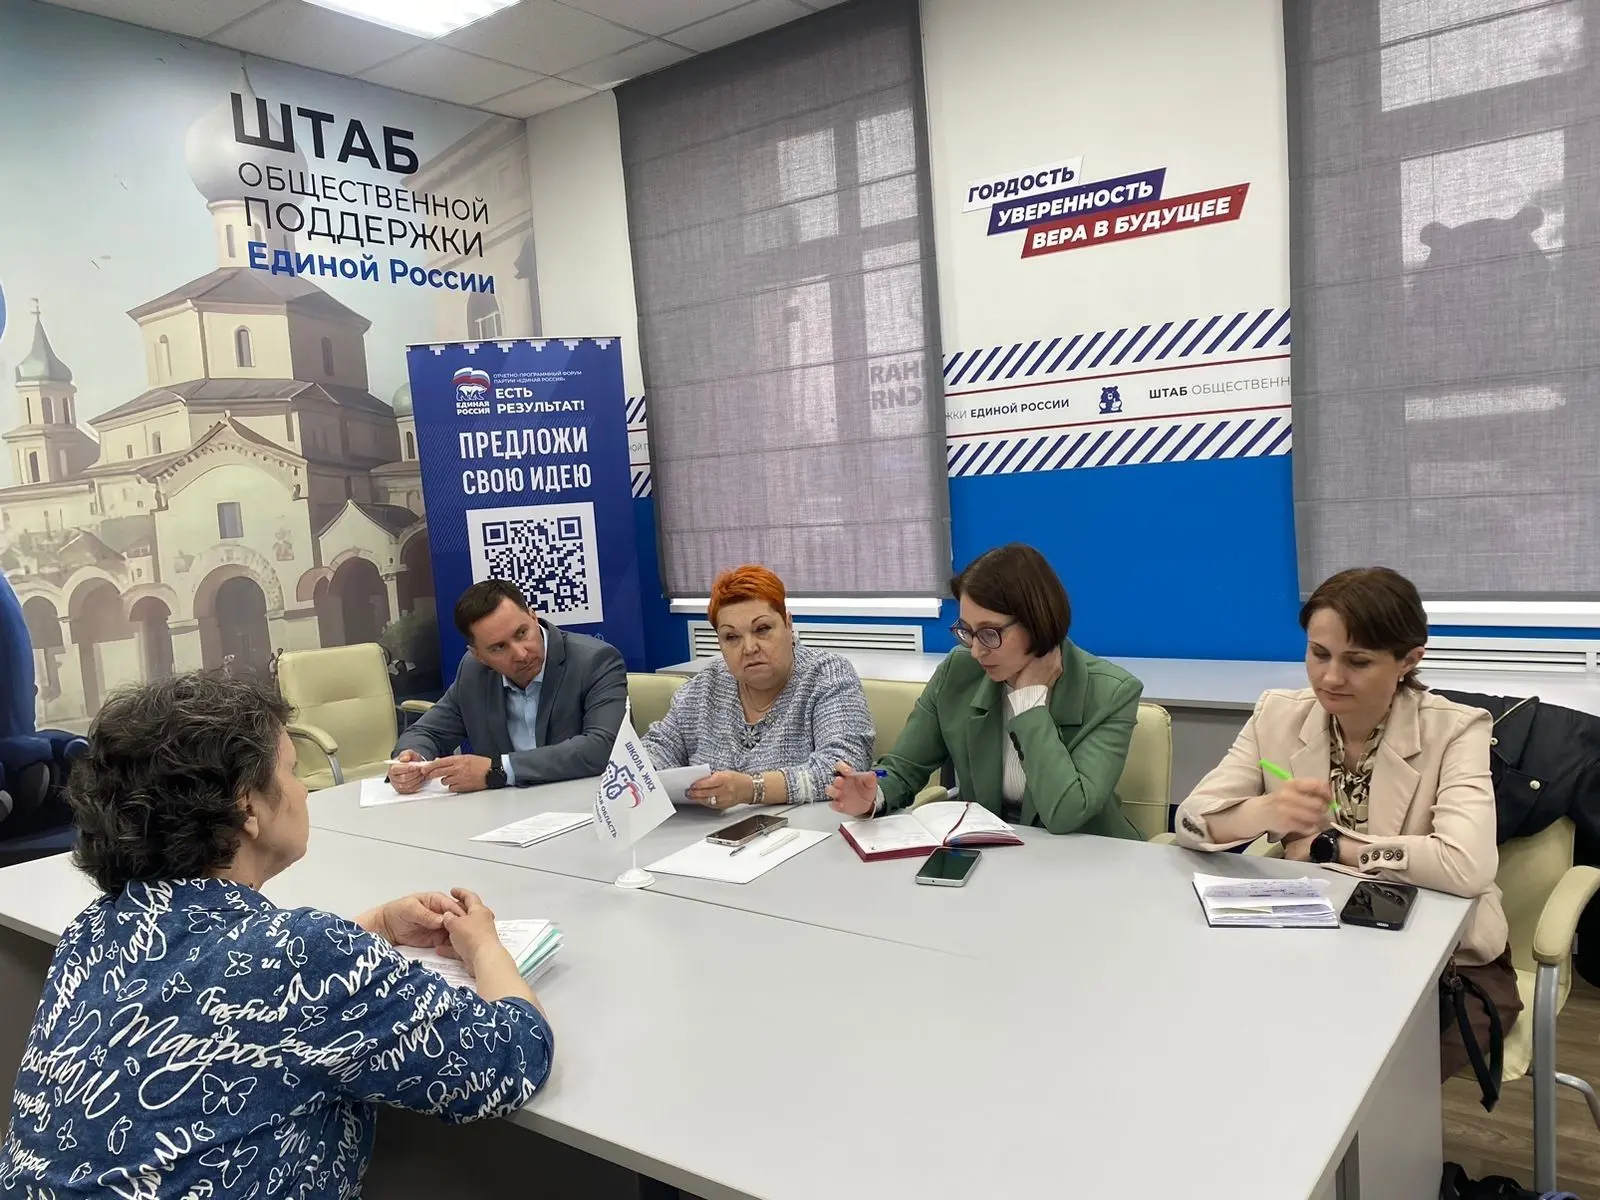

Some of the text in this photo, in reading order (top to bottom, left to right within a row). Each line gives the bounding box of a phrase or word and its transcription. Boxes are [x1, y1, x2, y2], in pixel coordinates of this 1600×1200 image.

[230, 92, 419, 174] ШТАБ
[238, 161, 489, 225] ОБЩЕСТВЕННОЙ
[968, 166, 1075, 203] ГОРДОСТЬ
[997, 181, 1154, 227] УВЕРЕННОСТЬ
[244, 196, 484, 257] ПОДДЕРЖКИ
[1032, 196, 1232, 249] ВЕРА В БУДУЩЕЕ
[456, 401, 490, 409] ЕДИНАЯ
[495, 387, 533, 399] ЕСТЬ
[497, 400, 585, 414] РЕЗУЛЬТАТ!
[970, 402, 1018, 419] ЕДИНОЙ
[1020, 398, 1070, 413] РОССИИ
[1149, 386, 1188, 400] ШТАБ
[456, 408, 490, 416] РОССИЯ
[459, 426, 588, 460] ПРЕДЛОЖИ
[462, 463, 592, 495] СВОЮ ИДЕЮ
[624, 741, 657, 793] ШКОЛА ЖКХ
[601, 805, 617, 838] ОБЛАСТЬ
